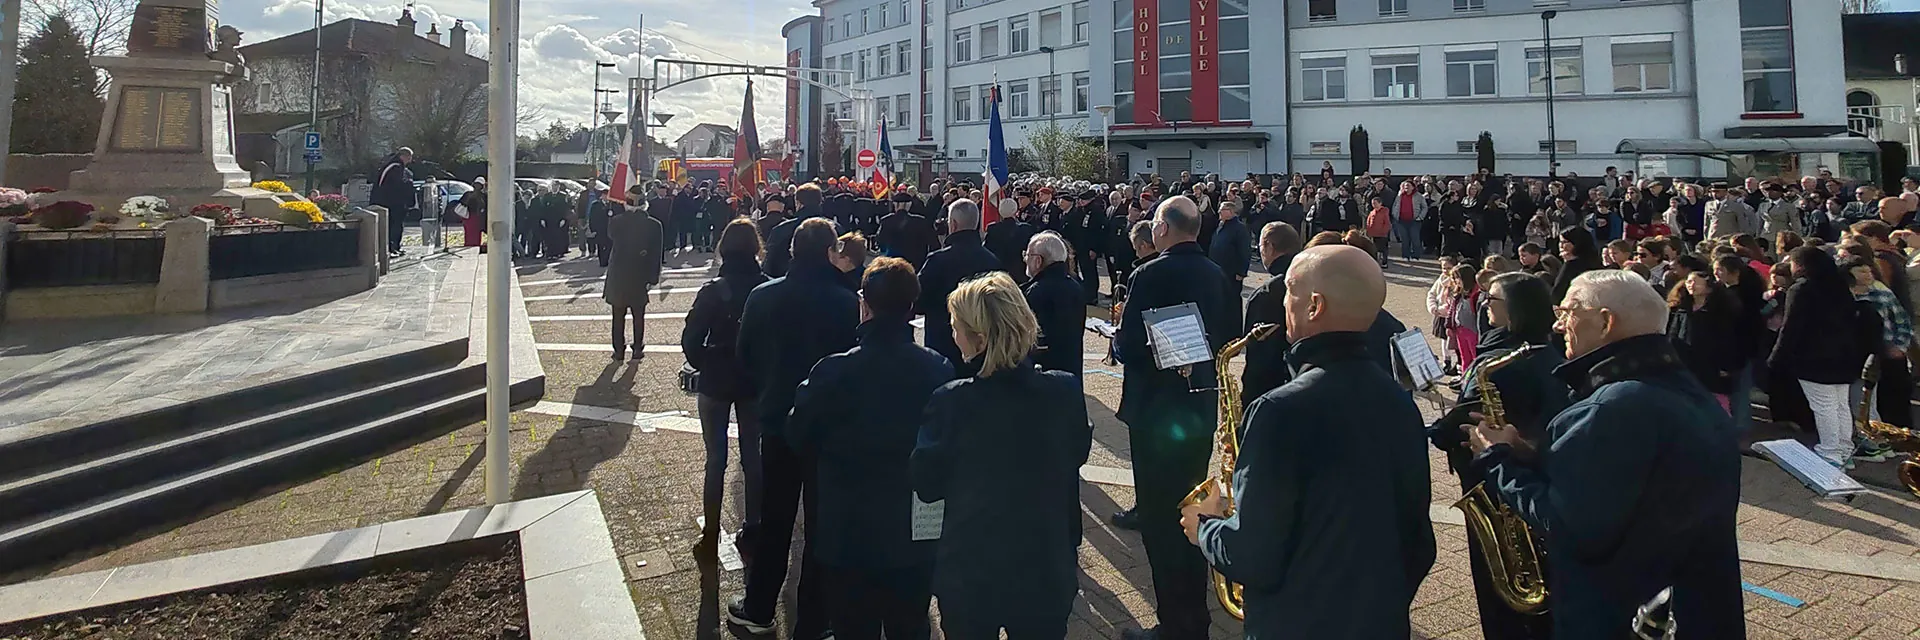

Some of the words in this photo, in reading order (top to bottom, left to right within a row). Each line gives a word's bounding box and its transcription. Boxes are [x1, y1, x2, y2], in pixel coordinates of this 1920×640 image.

[1139, 7, 1149, 76] HOTEL
[1165, 35, 1184, 45] DE
[1197, 0, 1209, 72] VILLE
[309, 135, 317, 146] P
